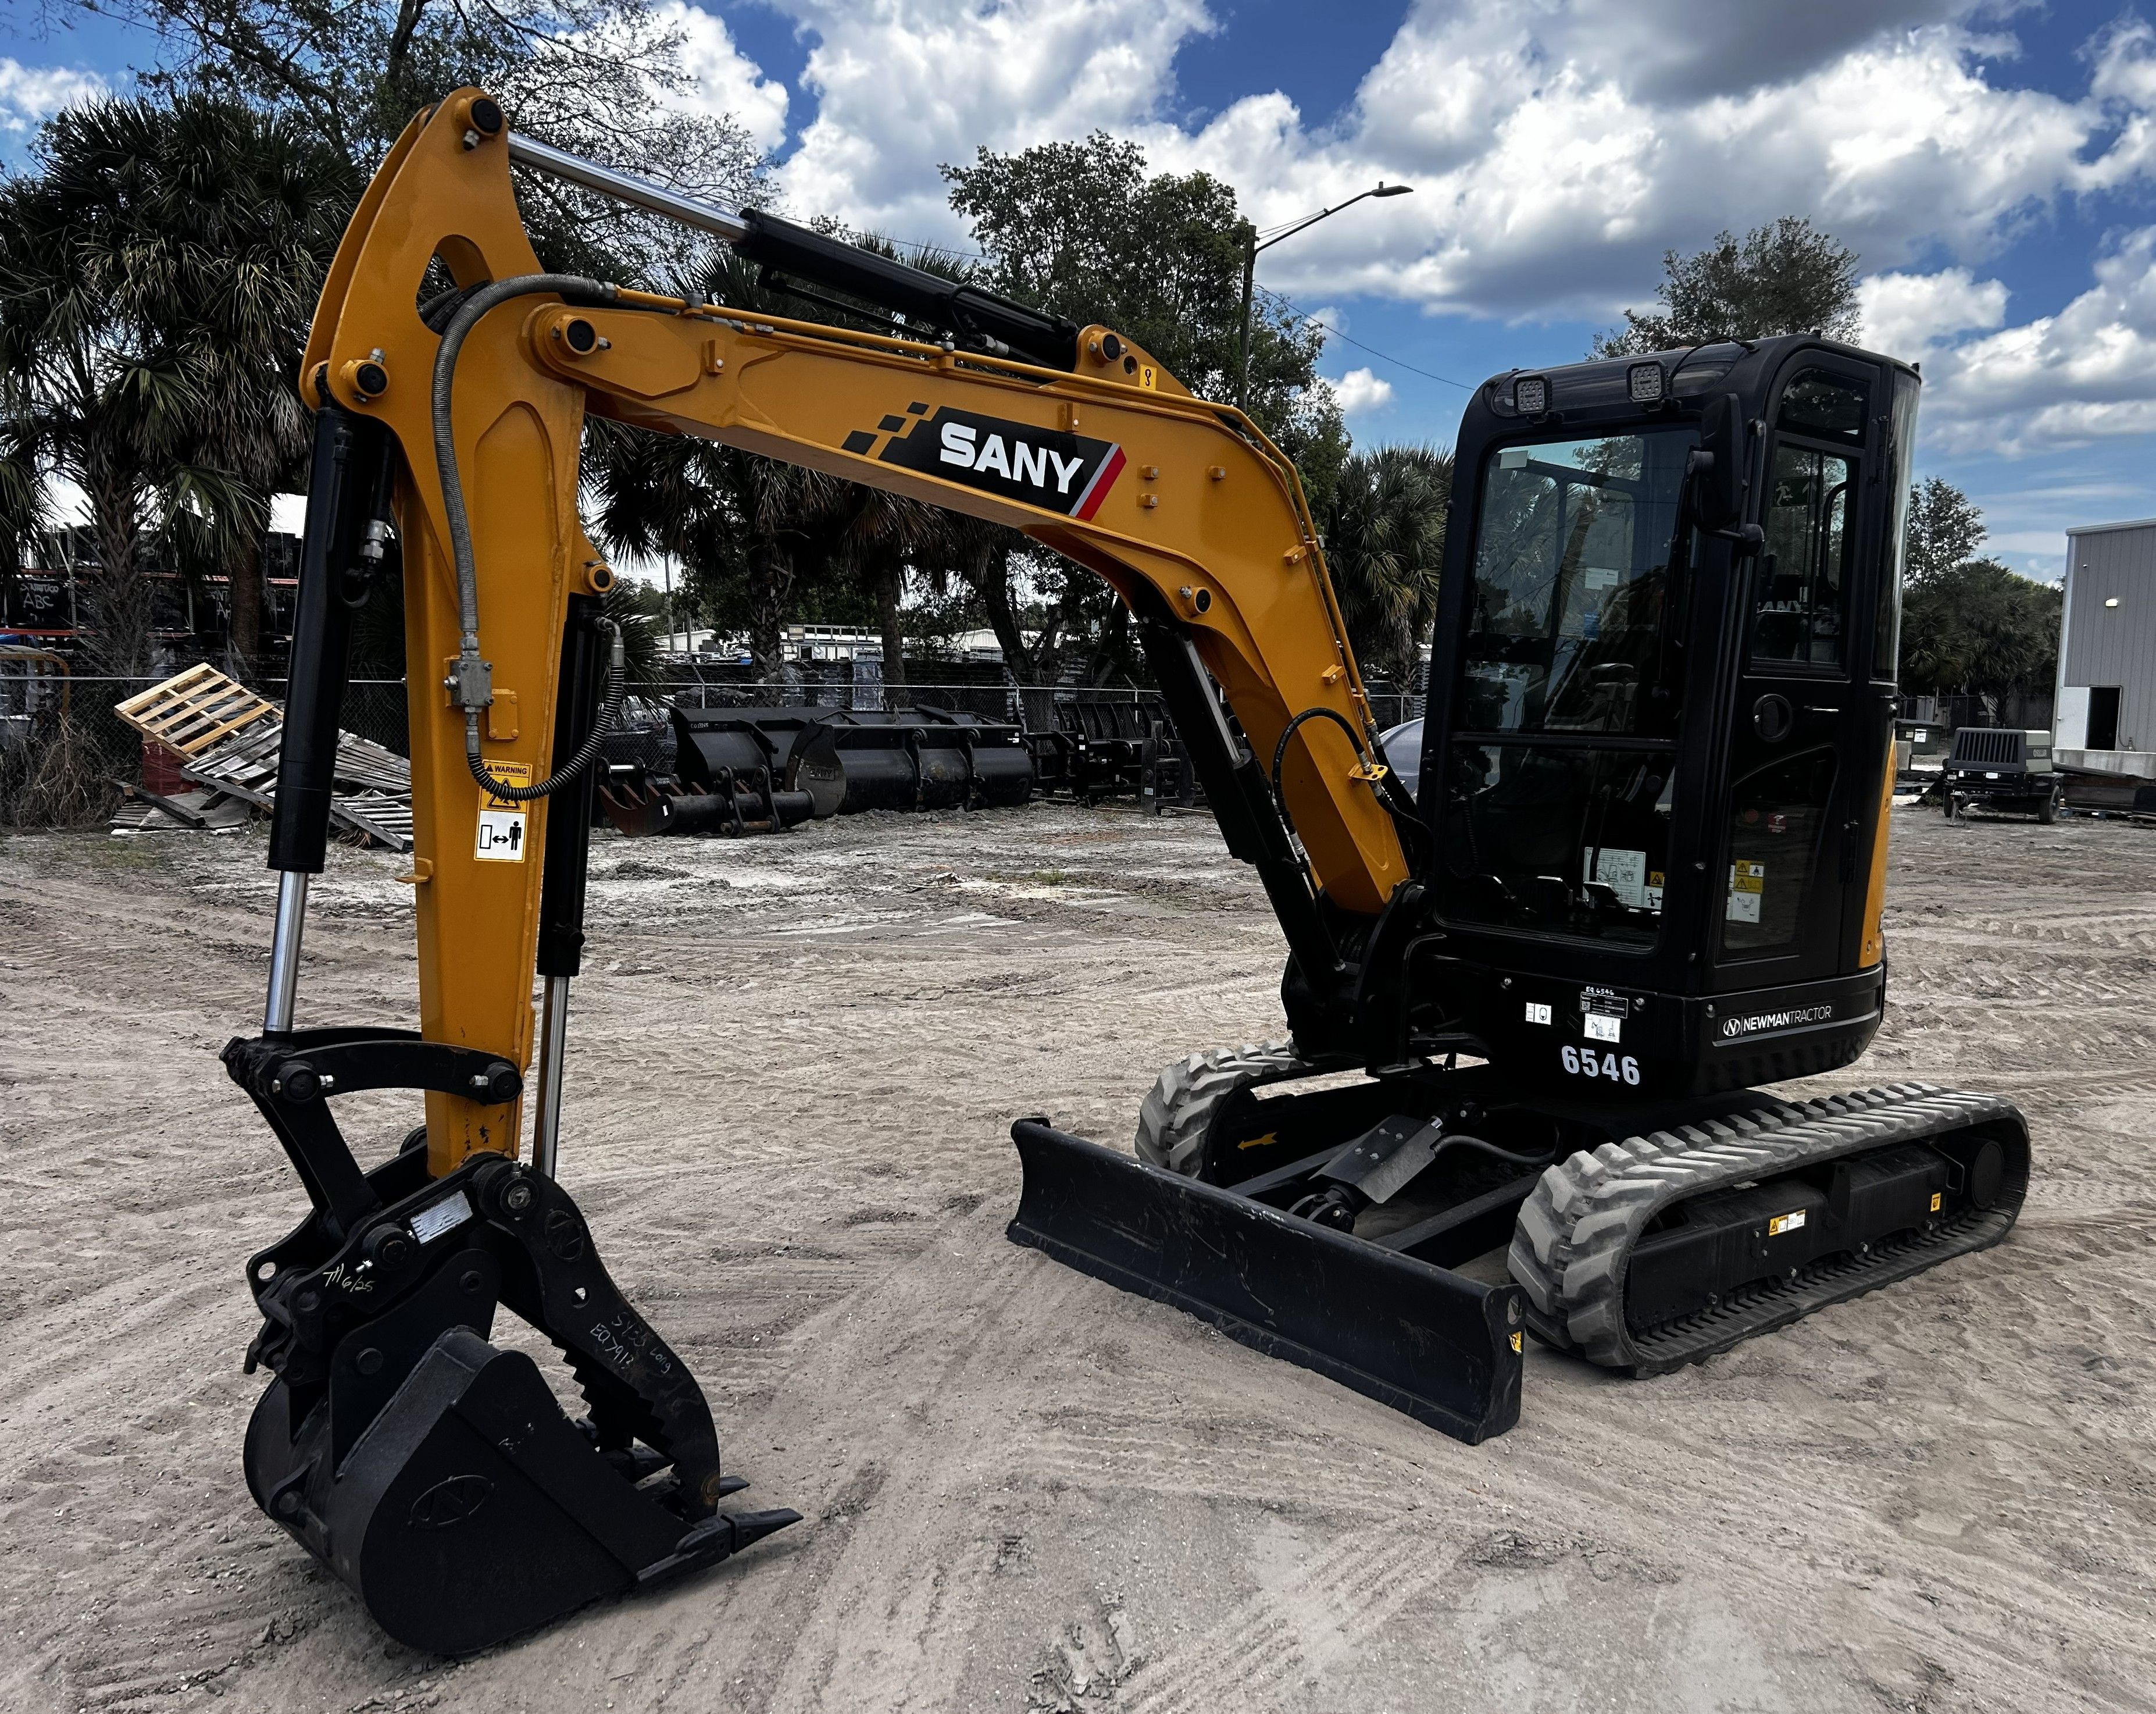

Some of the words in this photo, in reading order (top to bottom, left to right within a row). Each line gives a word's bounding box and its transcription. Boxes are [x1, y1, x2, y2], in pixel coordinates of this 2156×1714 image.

[940, 421, 1084, 494] SANY
[23, 592, 55, 609] ABC
[494, 765, 527, 775] WARNING
[1561, 1045, 1640, 1085] 6546
